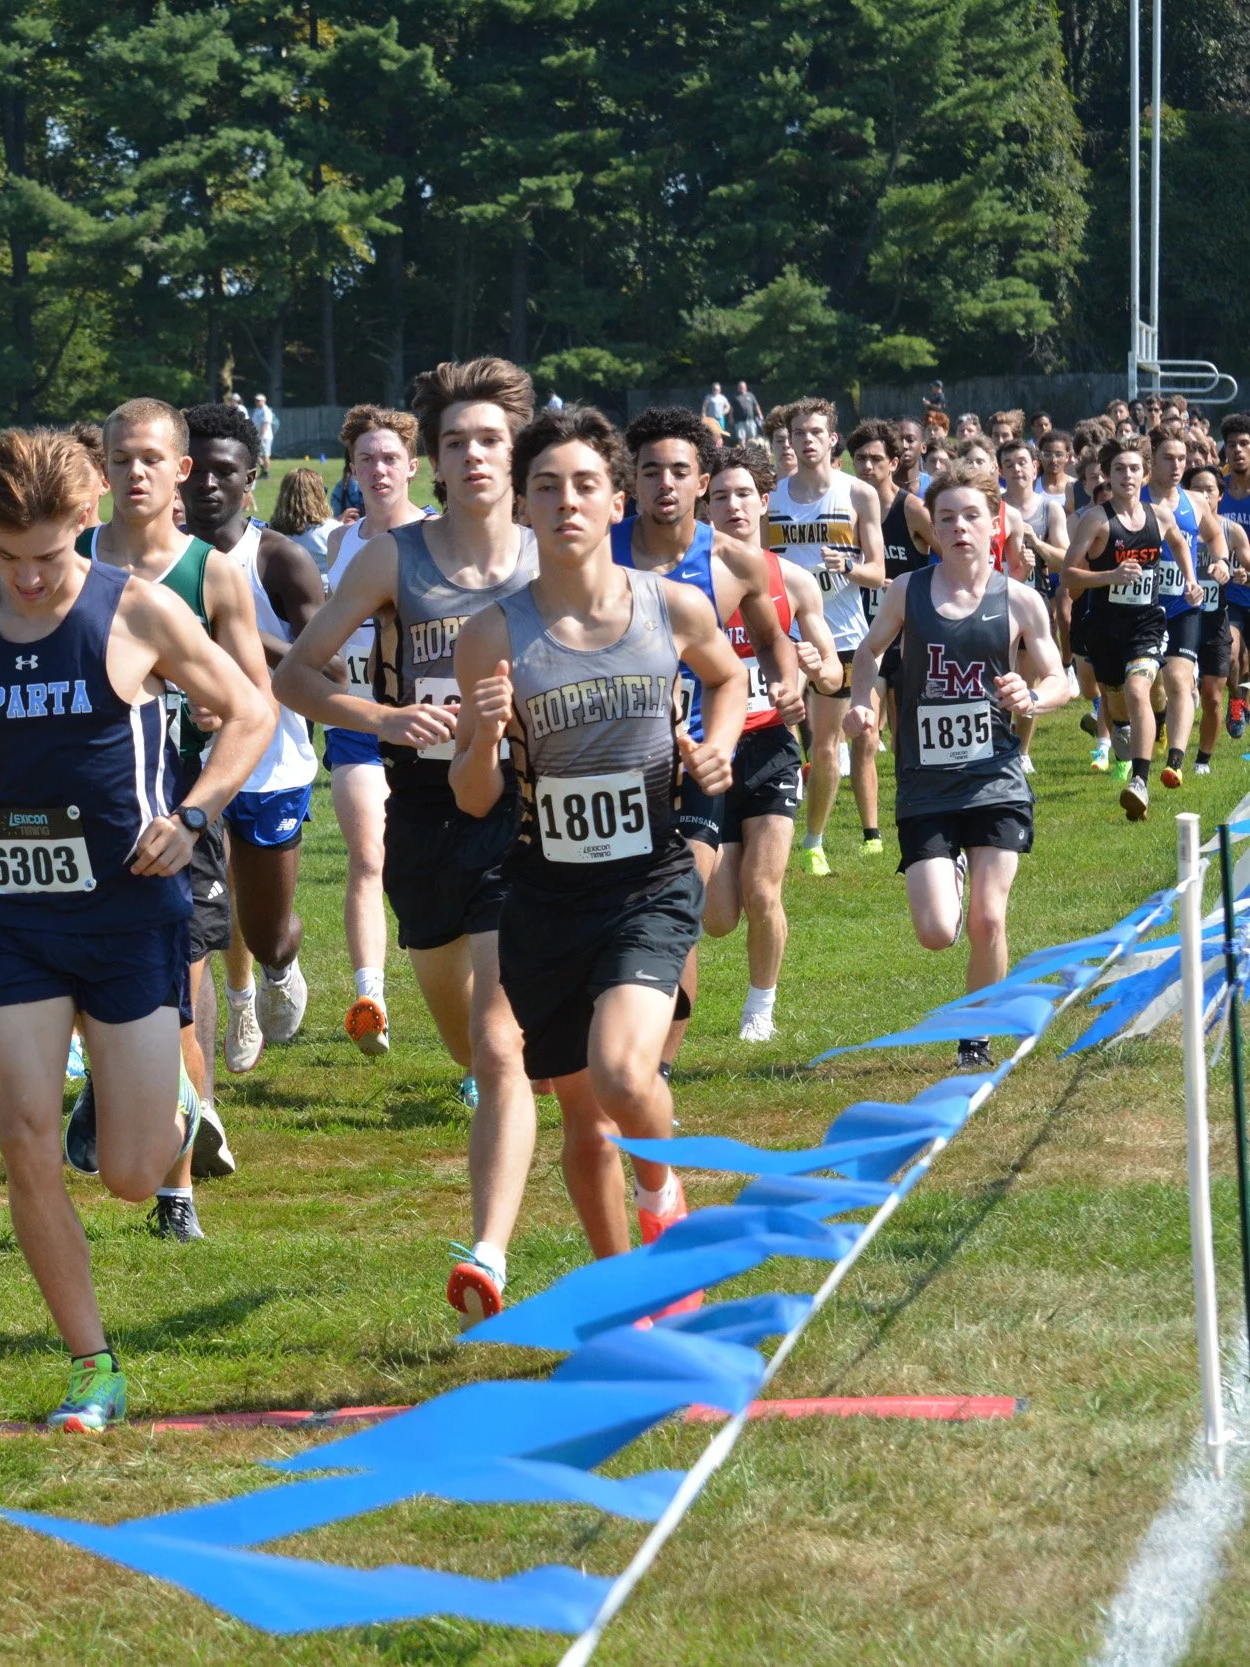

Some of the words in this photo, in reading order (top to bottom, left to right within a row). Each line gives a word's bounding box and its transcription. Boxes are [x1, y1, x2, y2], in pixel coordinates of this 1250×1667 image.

[782, 523, 829, 544] MCNAIR
[1115, 548, 1158, 563] WEST
[347, 655, 370, 685] 17
[927, 643, 986, 699] LM
[526, 675, 667, 740] HOPEWELL
[921, 712, 990, 750] 1835
[540, 786, 645, 842] 1805
